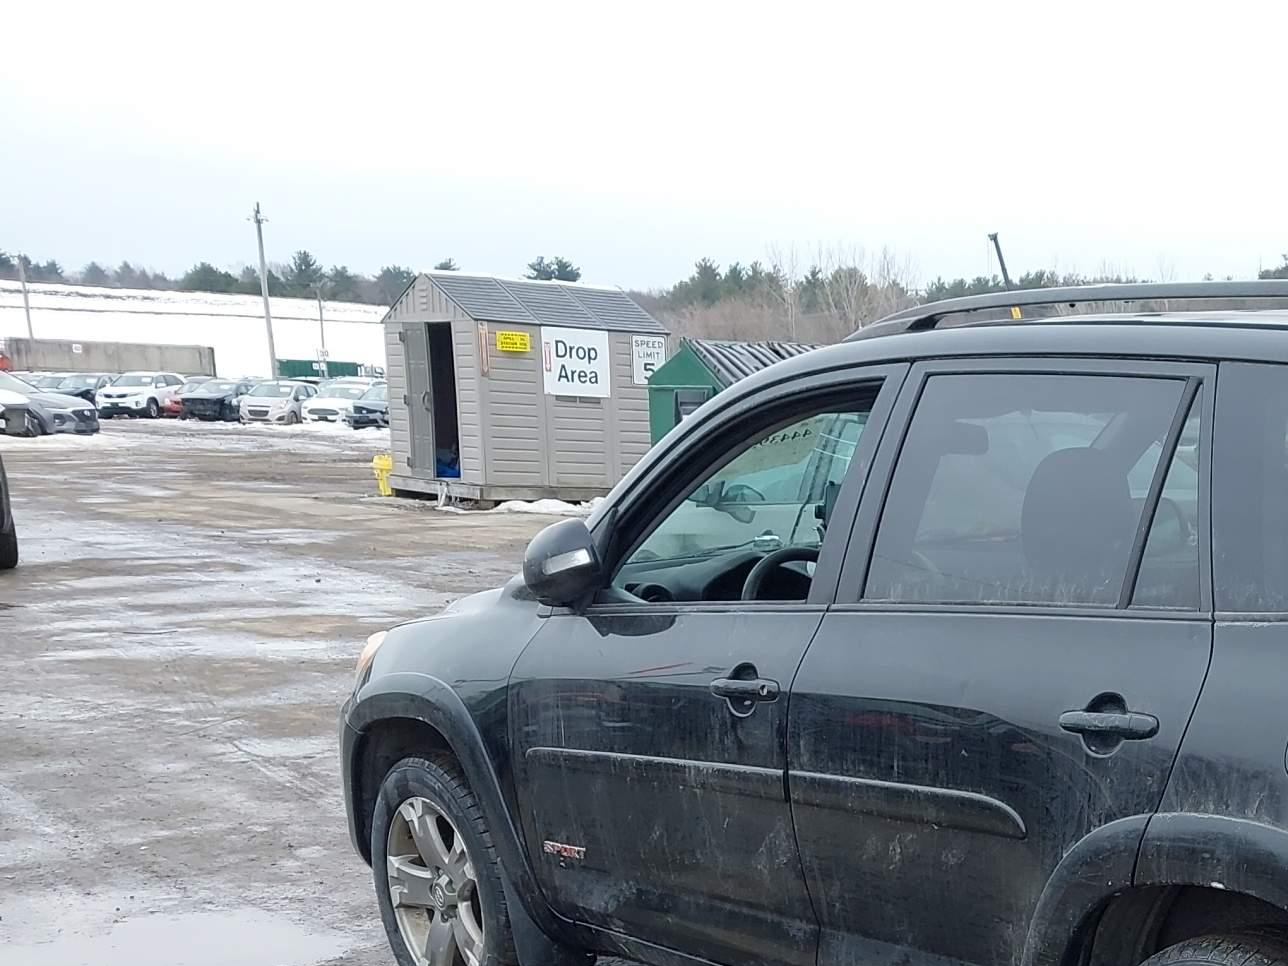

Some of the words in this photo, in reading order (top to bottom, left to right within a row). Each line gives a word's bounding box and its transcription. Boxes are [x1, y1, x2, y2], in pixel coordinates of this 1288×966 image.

[555, 340, 598, 364] Drop
[634, 340, 663, 349] SPEED
[637, 352, 660, 360] LIMIT
[557, 364, 599, 384] Area
[643, 363, 657, 380] 5
[543, 840, 586, 859] SPORT
